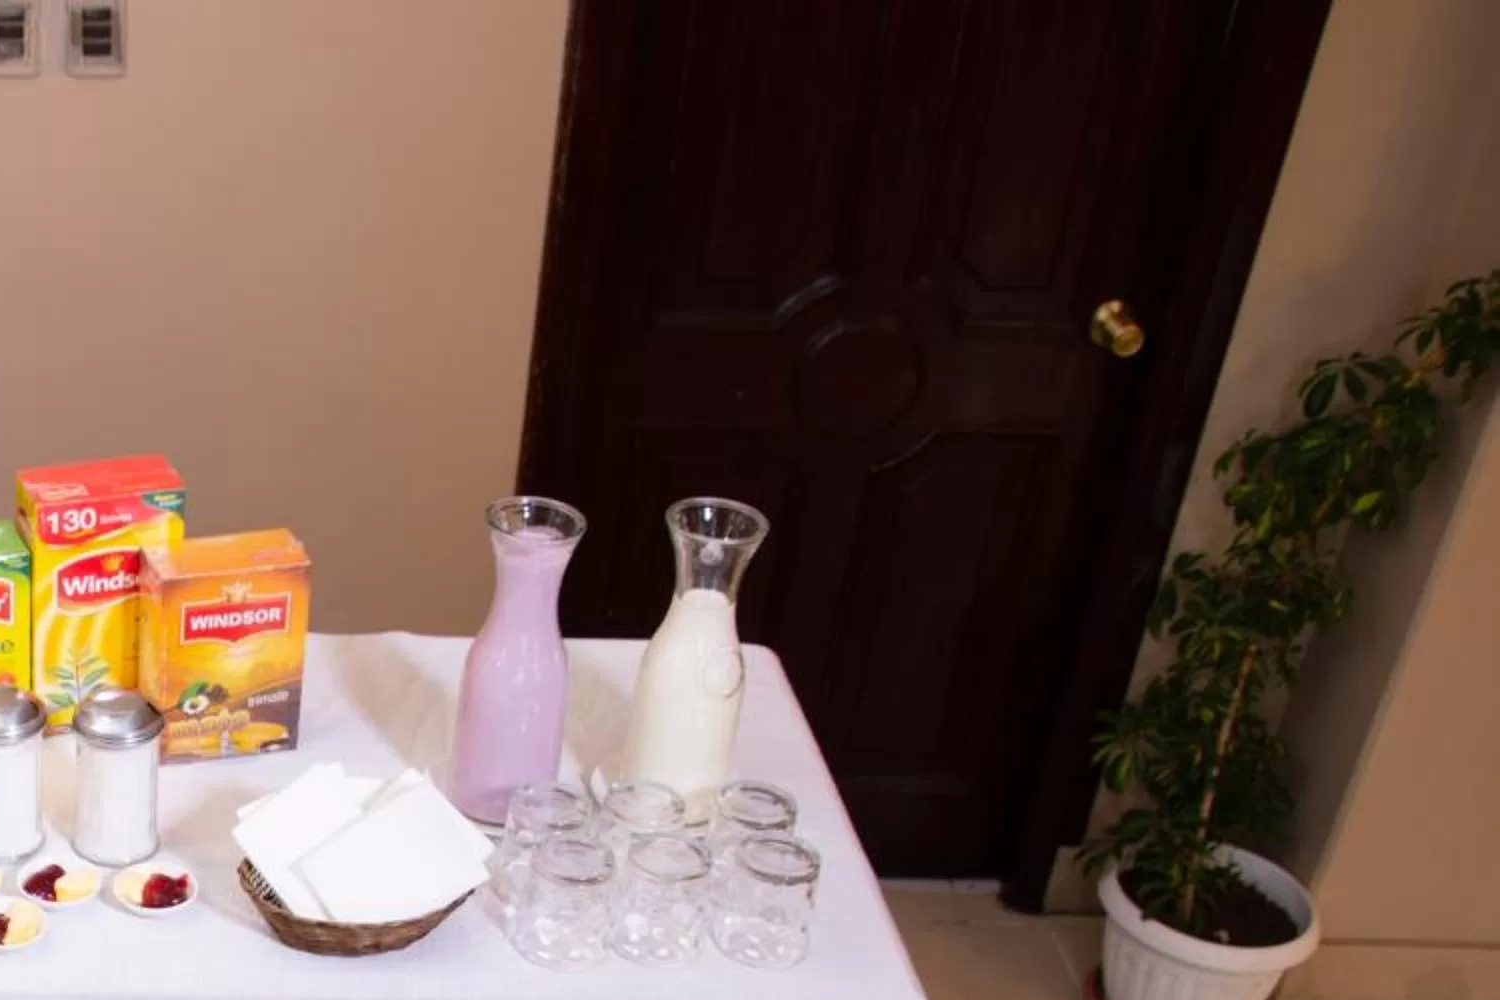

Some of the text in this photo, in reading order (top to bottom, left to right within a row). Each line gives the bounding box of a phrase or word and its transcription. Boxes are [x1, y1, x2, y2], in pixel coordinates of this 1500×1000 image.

[47, 507, 97, 534] 130
[62, 570, 137, 597] Winds
[190, 607, 283, 631] WINDSOR
